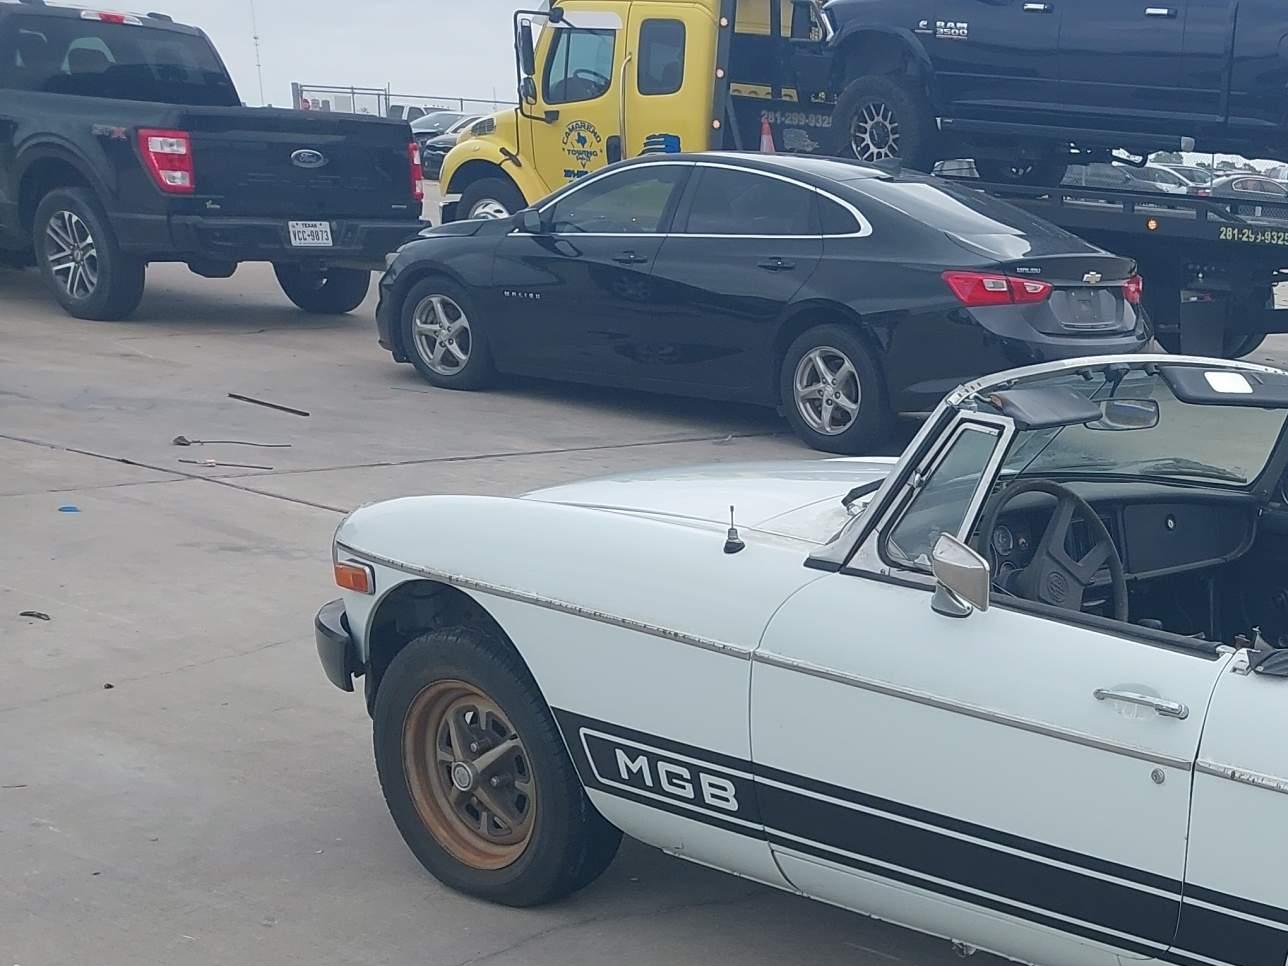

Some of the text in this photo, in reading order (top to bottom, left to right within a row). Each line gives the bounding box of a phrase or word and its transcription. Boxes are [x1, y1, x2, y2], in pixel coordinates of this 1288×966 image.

[936, 21, 968, 30] RAM
[567, 148, 598, 157] TOWING
[615, 748, 739, 812] MGB
